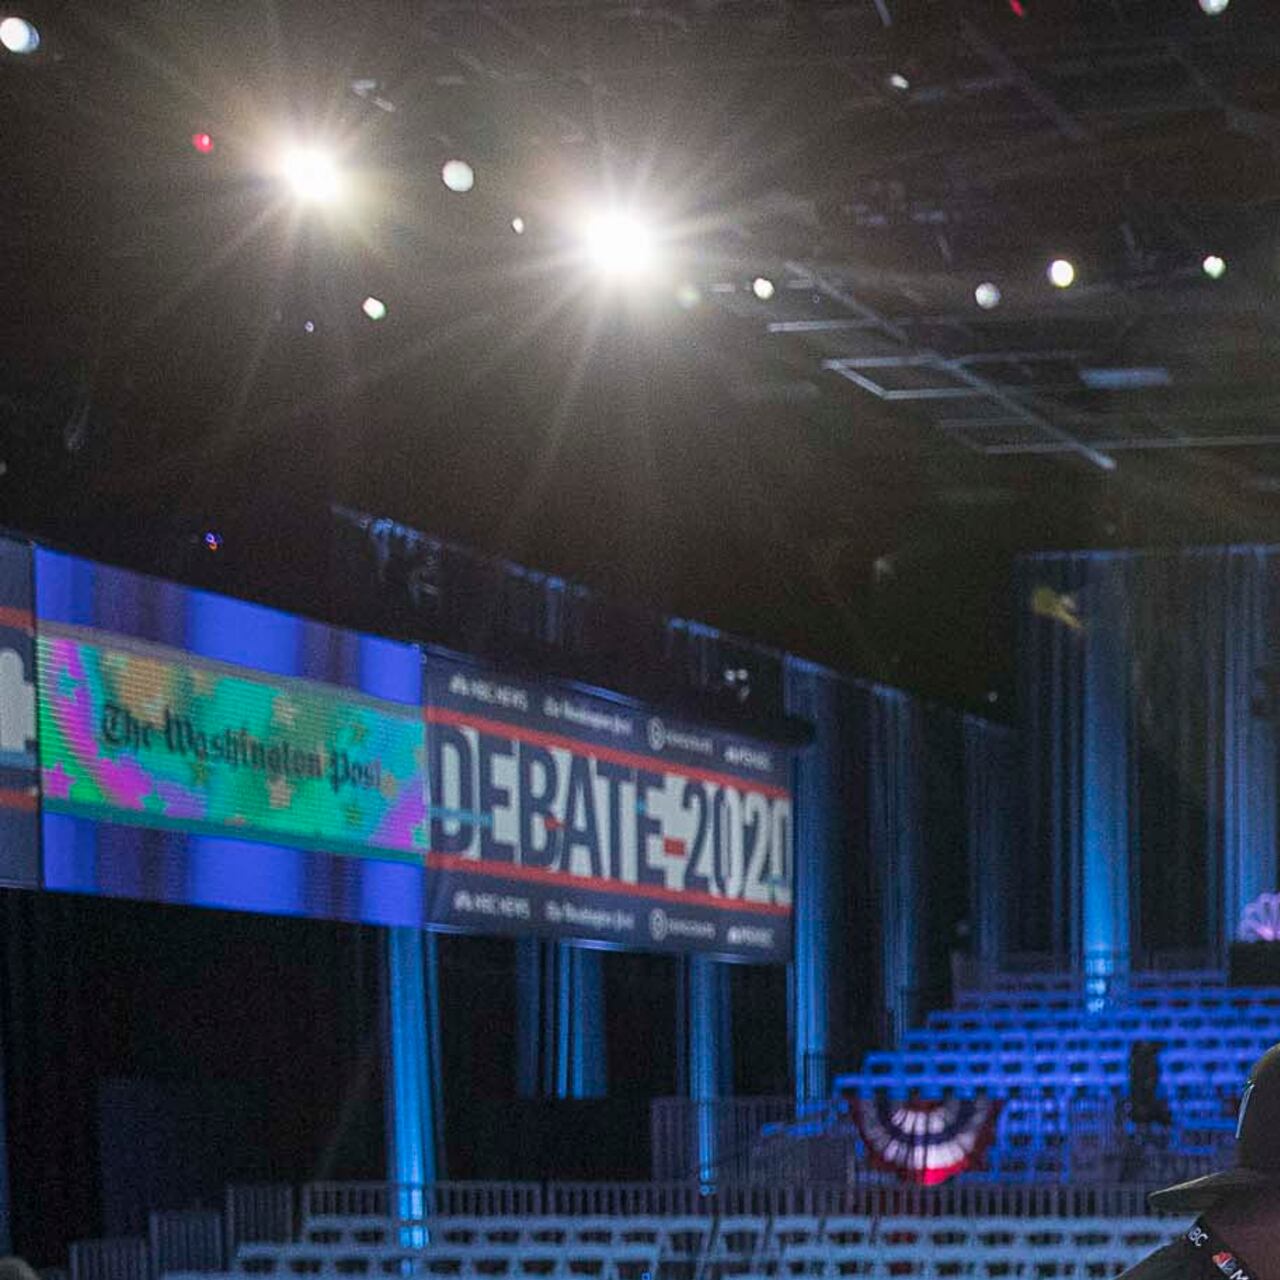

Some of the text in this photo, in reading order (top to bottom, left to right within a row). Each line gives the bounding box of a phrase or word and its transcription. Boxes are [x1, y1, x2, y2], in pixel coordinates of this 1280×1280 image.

[102, 700, 382, 794] The Washington Post
[428, 722, 793, 908] DEBATE 2020
